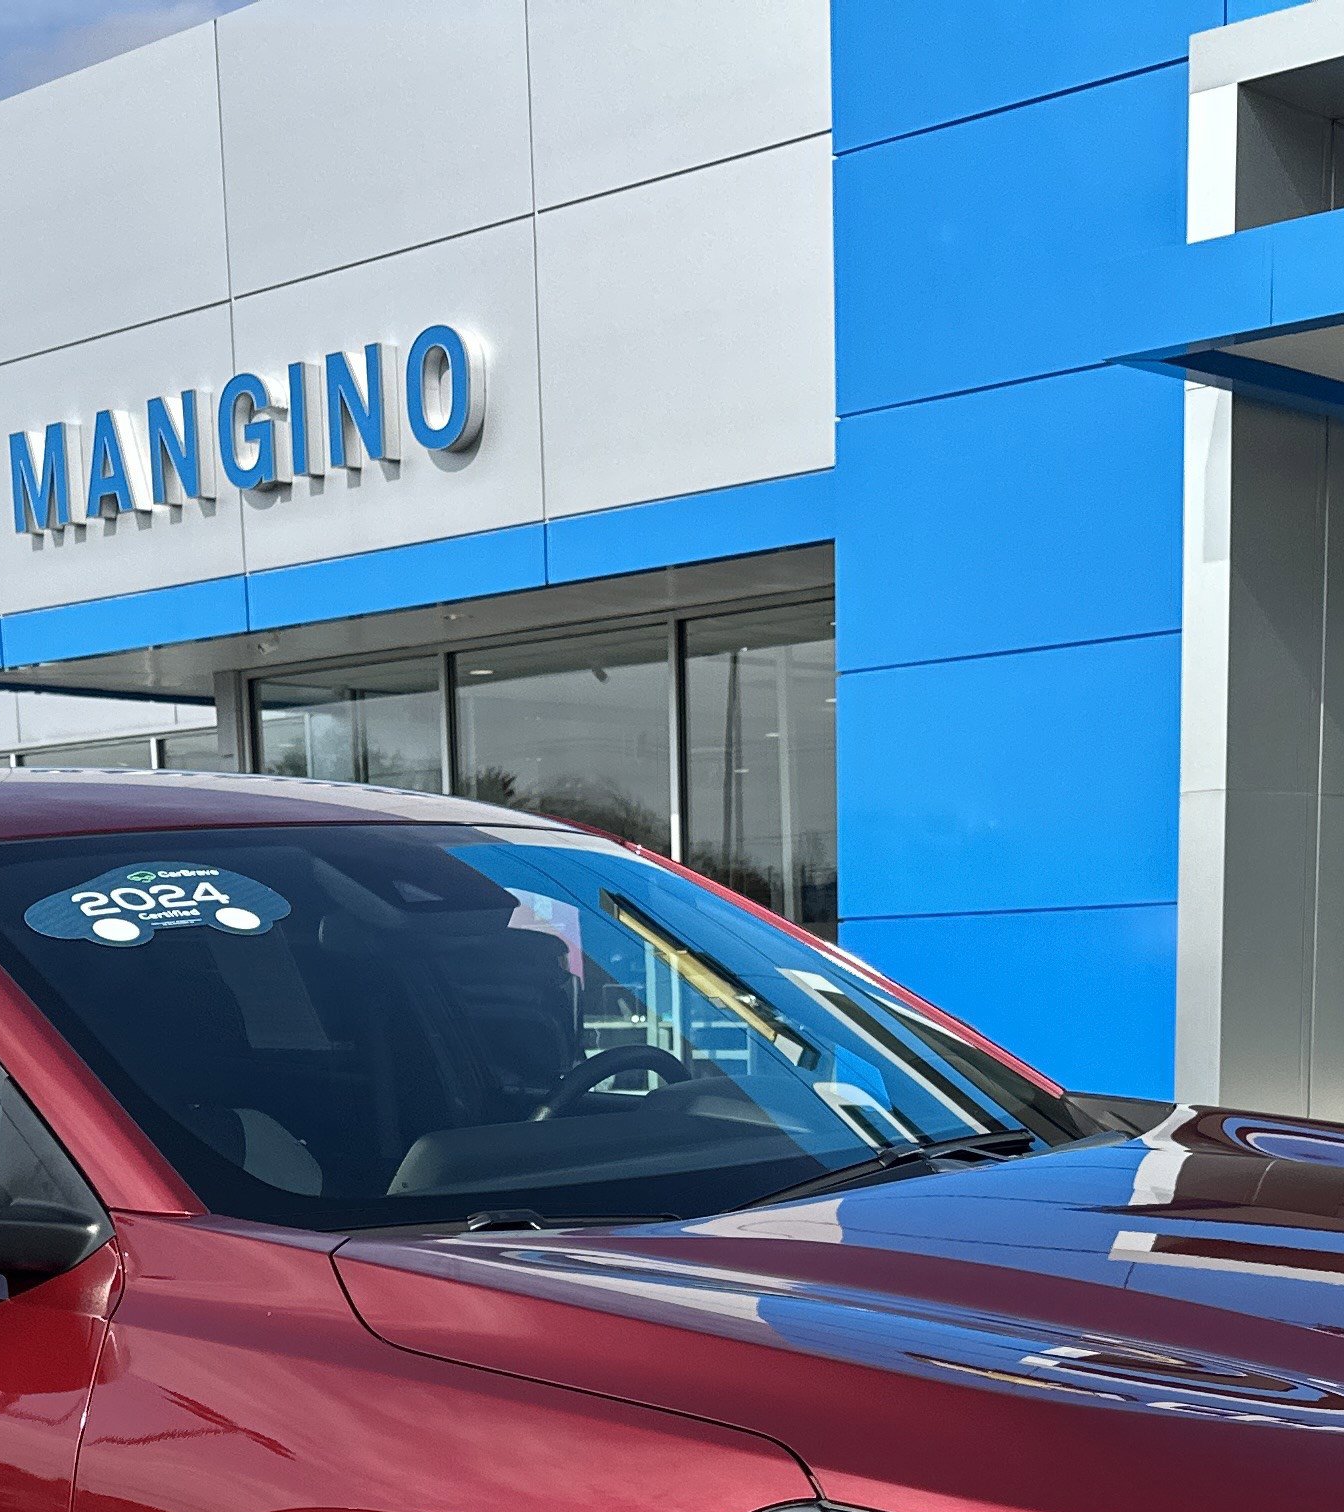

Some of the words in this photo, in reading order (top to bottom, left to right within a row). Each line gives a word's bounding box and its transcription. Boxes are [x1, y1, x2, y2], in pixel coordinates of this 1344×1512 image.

[9, 324, 488, 536] MANGINO
[71, 881, 230, 917] 2024
[138, 908, 201, 920] Certified
